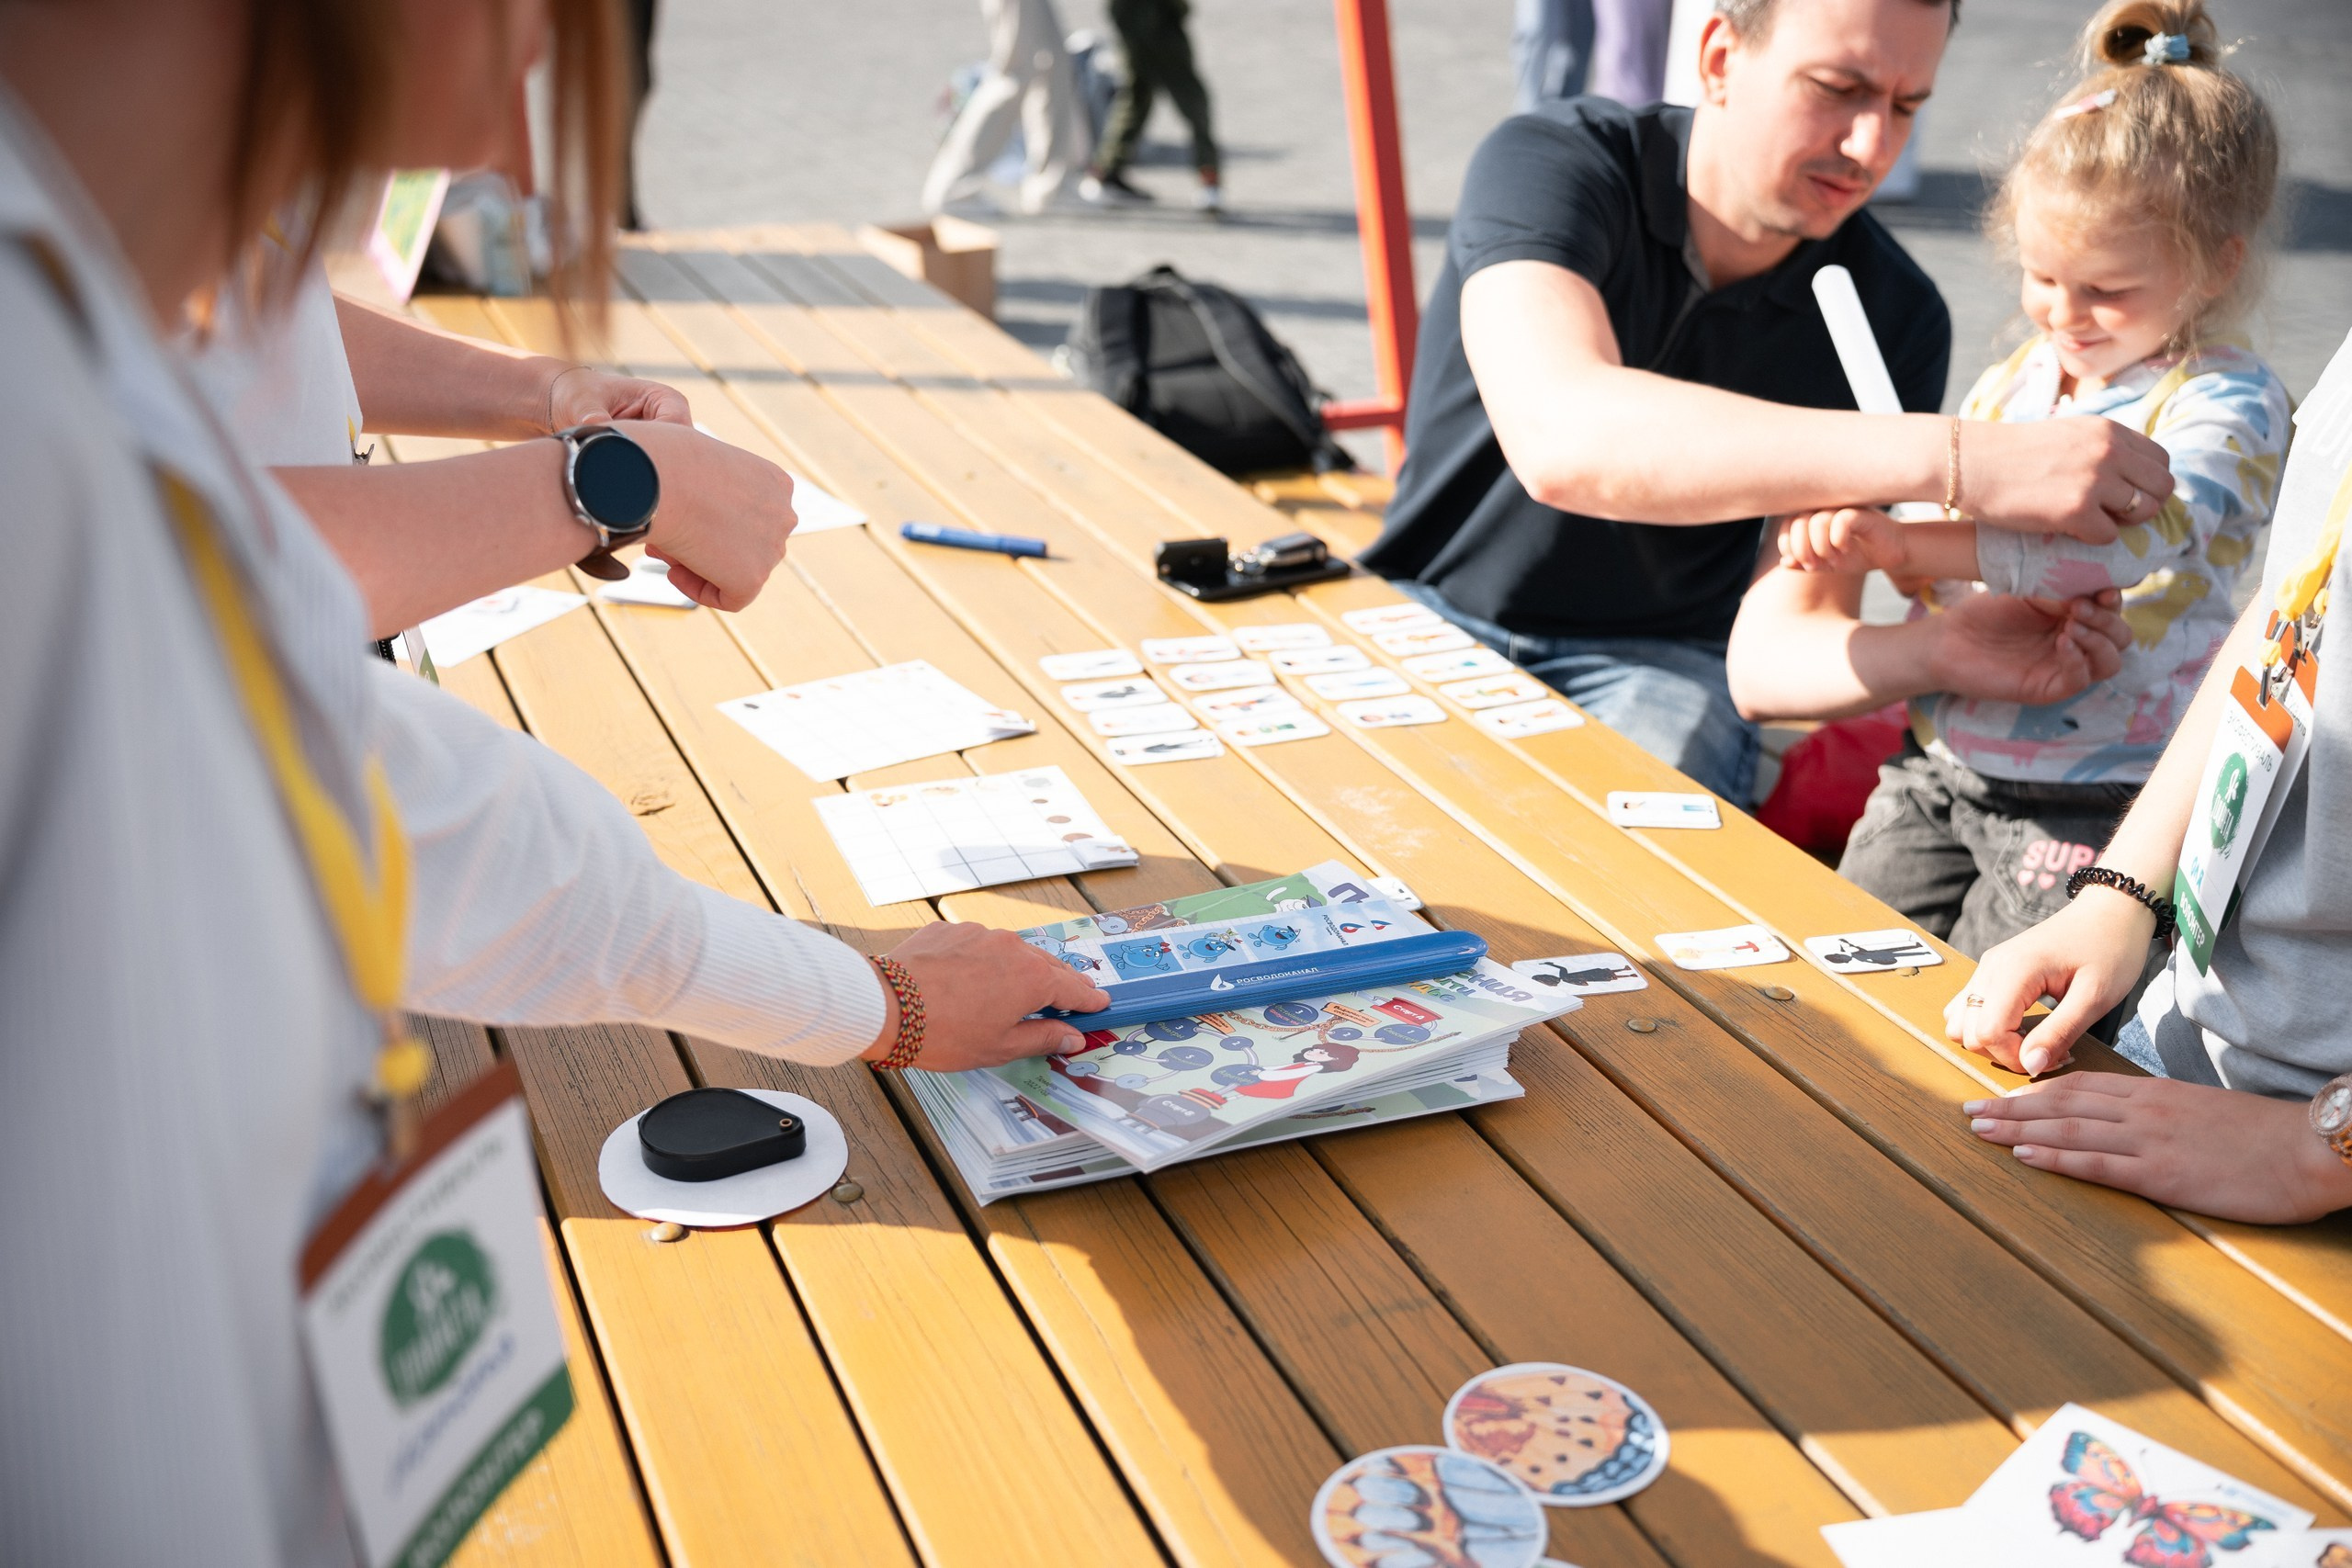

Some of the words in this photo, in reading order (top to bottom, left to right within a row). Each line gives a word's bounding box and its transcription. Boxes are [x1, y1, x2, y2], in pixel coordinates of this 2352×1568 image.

[2023, 840, 2105, 875] SUP
[2178, 891, 2206, 949] ВОЛОНТЕР
[1236, 966, 1319, 985] РОСВОДОКАНАЛ
[1393, 1004, 1418, 1017] Старт
[1161, 1100, 1188, 1112] Старт
